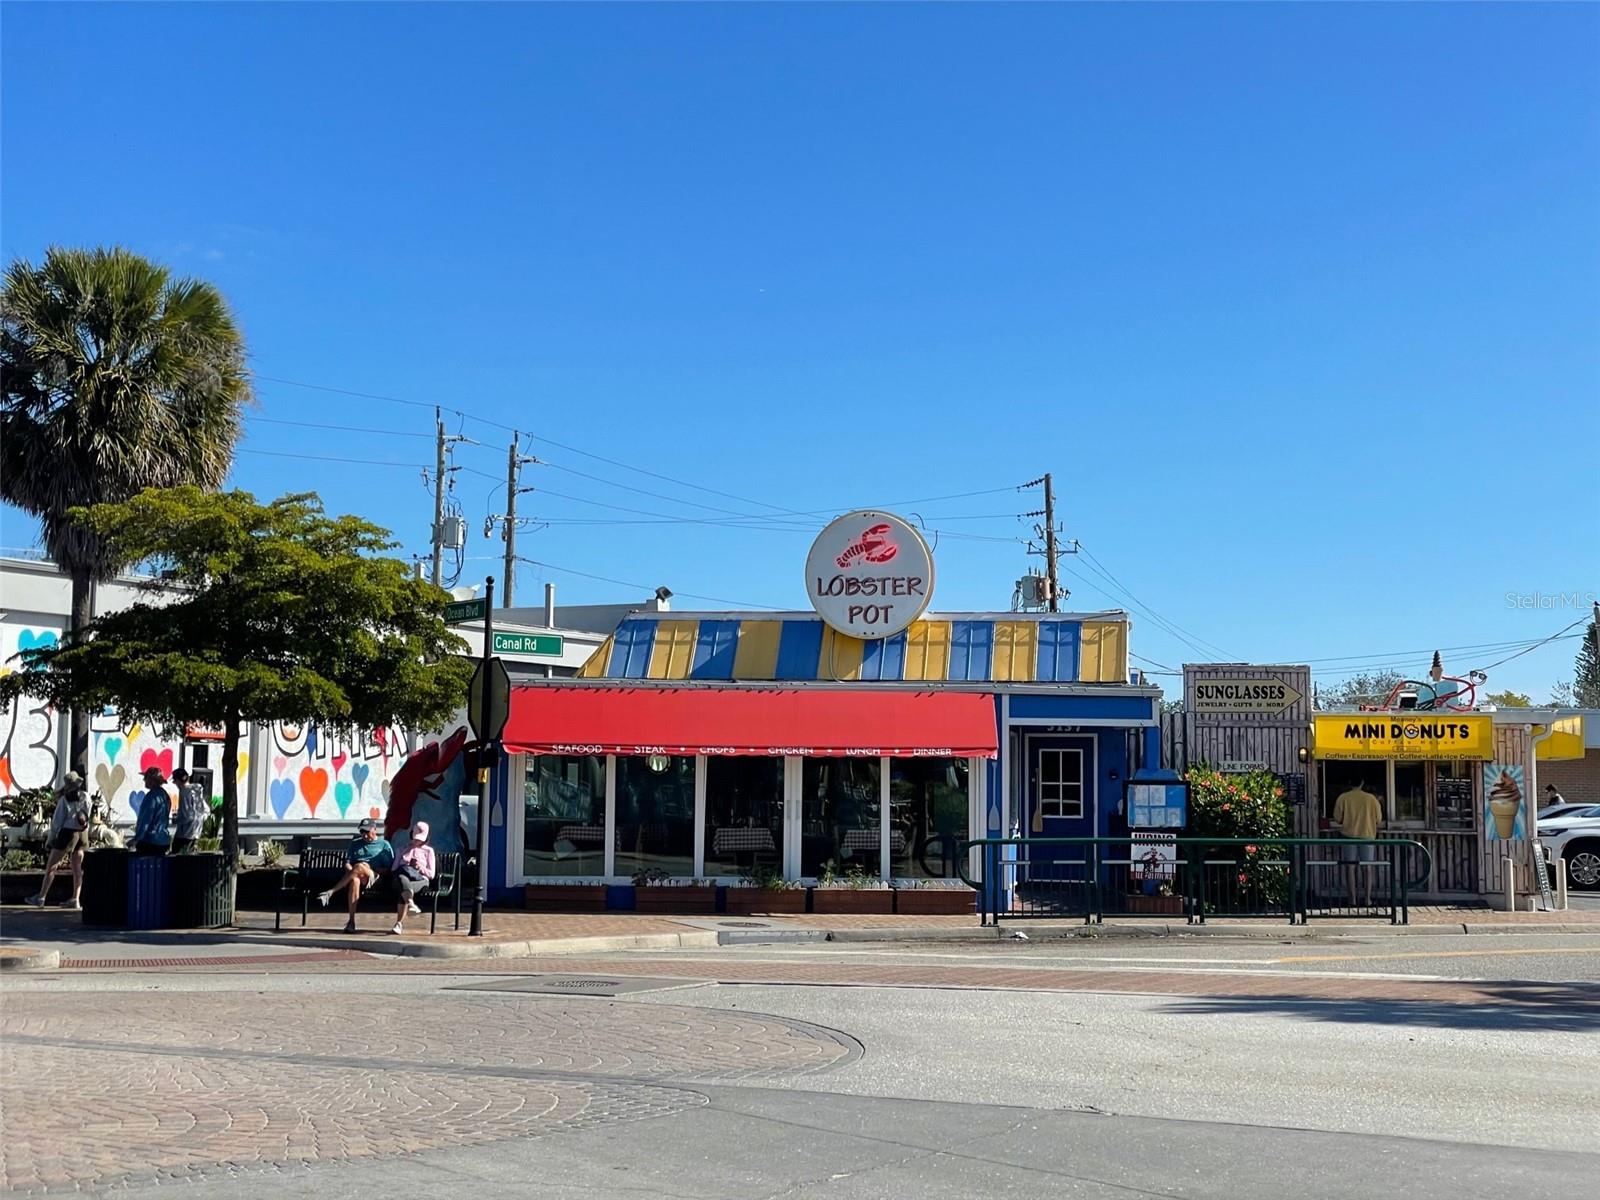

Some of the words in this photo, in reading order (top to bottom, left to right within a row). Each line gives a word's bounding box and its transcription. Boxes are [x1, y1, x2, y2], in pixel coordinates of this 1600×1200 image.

[817, 575, 923, 596] LOBSTER
[447, 607, 465, 619] Ocean
[466, 604, 479, 617] Blvd
[848, 604, 893, 624] POT
[495, 636, 522, 650] Canal
[524, 639, 537, 651] Rd
[1196, 685, 1285, 699] SUNGLASSES
[1344, 724, 1385, 739] MINI
[1391, 723, 1469, 739] DONUTS
[552, 745, 602, 753] SEAFOOD
[768, 747, 813, 755] CHICKEN
[914, 748, 951, 756] DINNER
[1352, 752, 1384, 760] Espresso
[1240, 763, 1264, 771] FORMS
